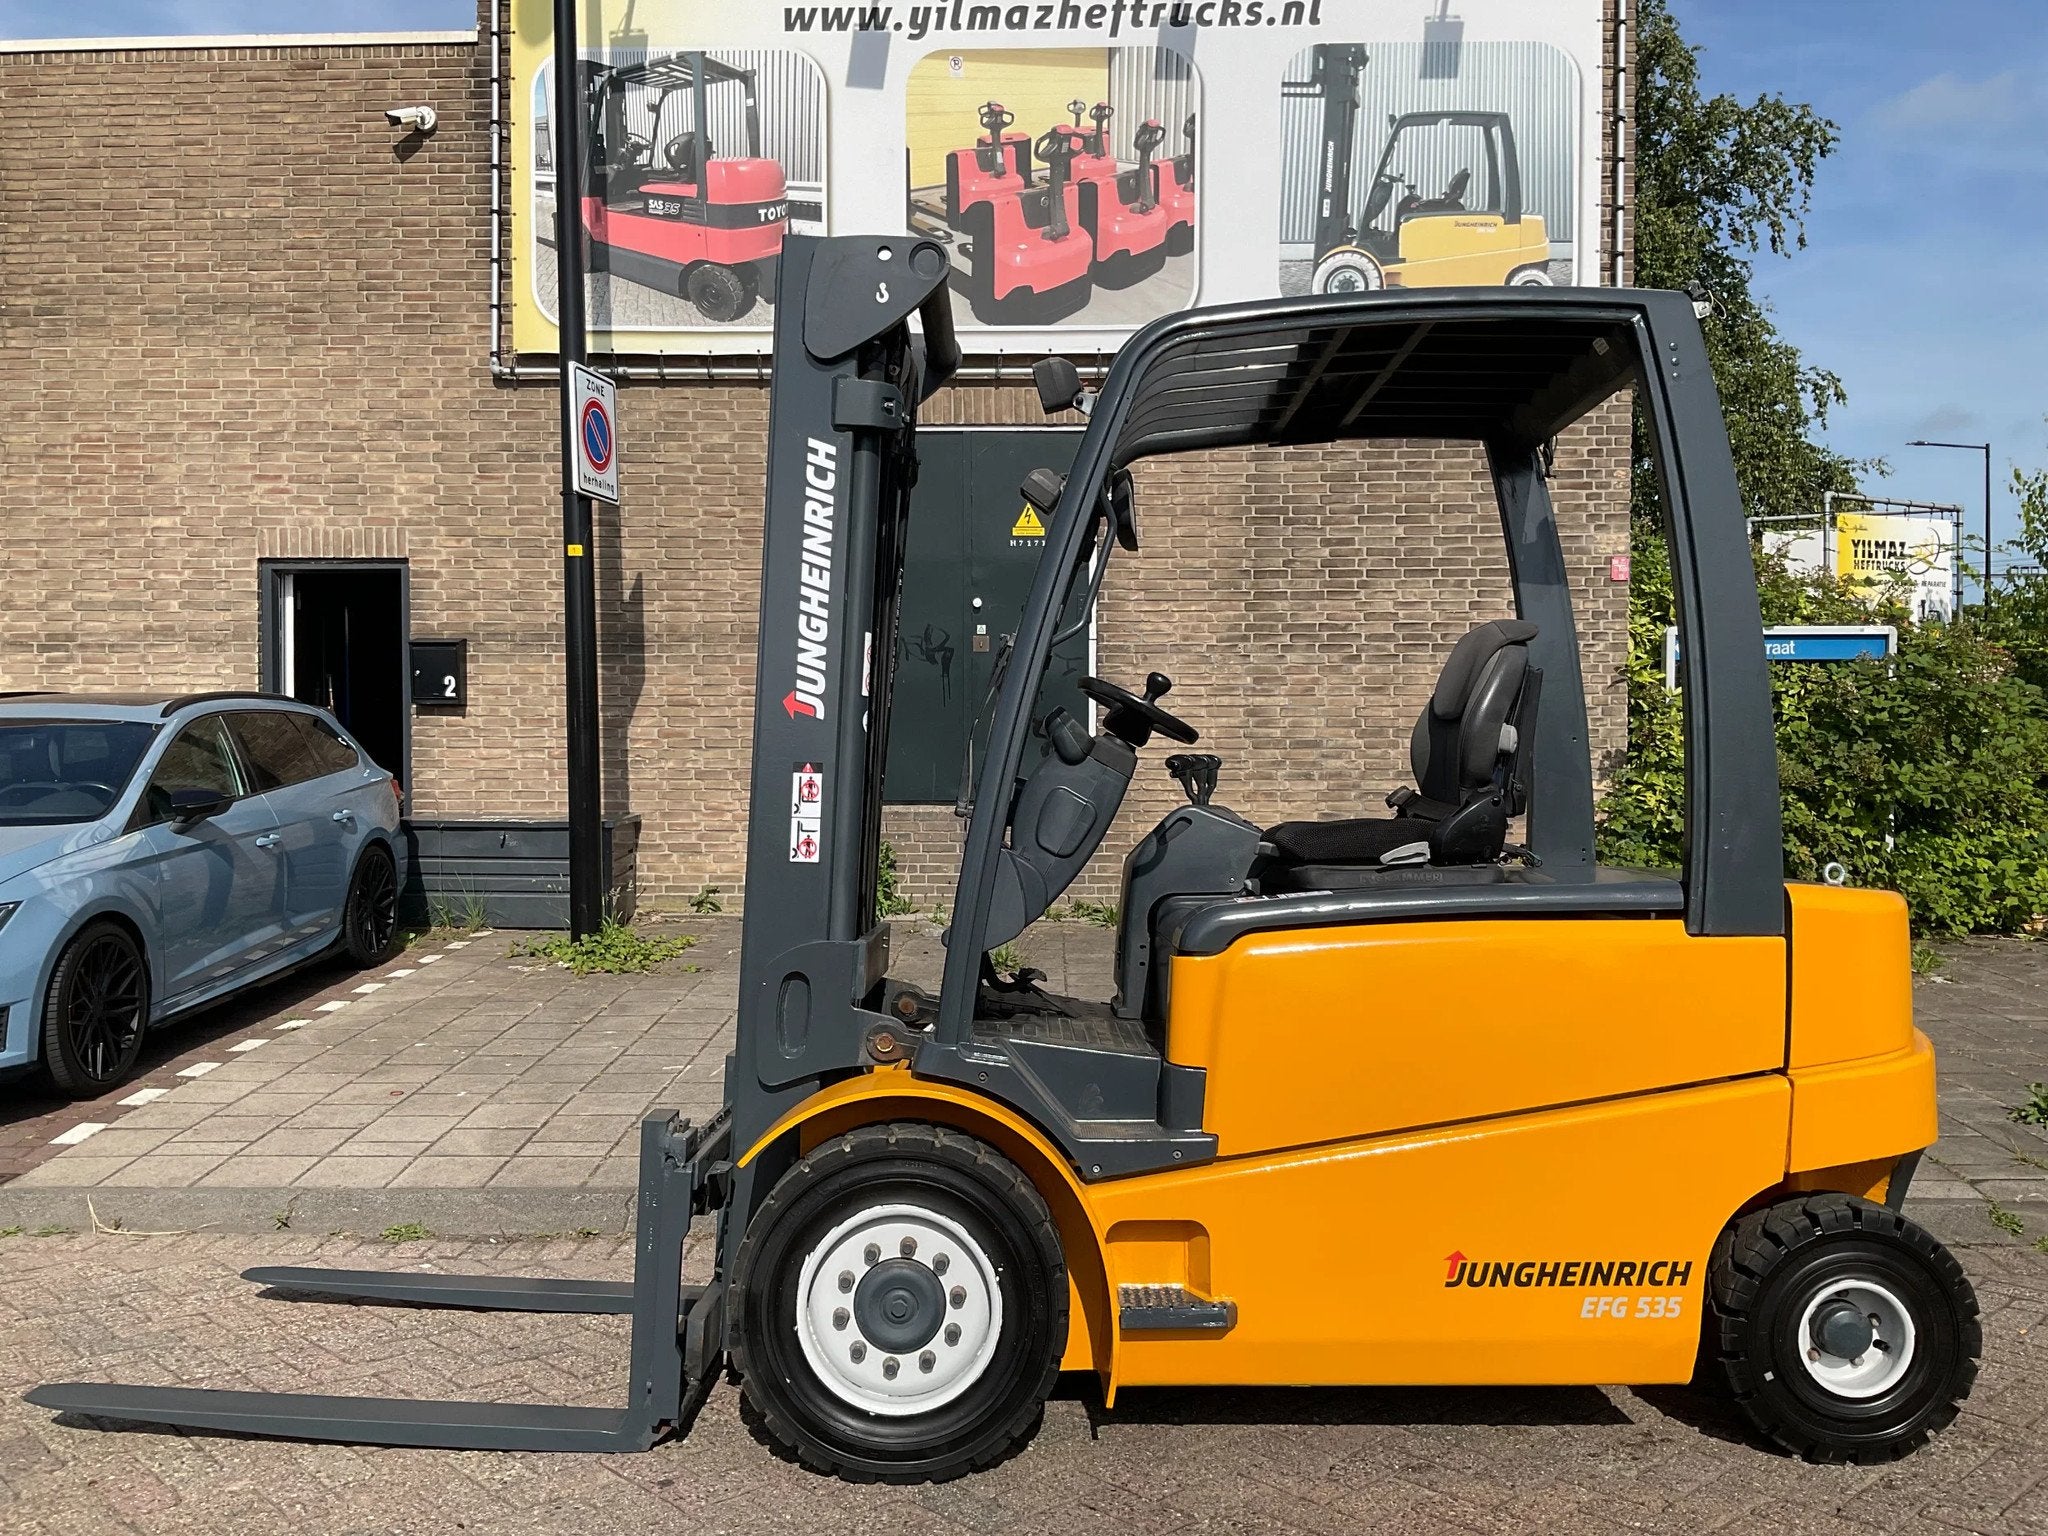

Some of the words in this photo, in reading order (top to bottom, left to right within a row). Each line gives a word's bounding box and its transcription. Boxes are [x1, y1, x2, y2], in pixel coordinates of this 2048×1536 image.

[784, 0, 1321, 40] www.yilmazheftrucks.nl
[648, 199, 664, 210] SAS
[586, 378, 605, 397] ZONE
[583, 472, 615, 496] herhaling
[1851, 539, 1906, 560] YILMAZ
[1853, 560, 1906, 572] HEFTRUCKS
[795, 437, 837, 720] JUNGHEINRICH
[444, 675, 456, 697] 2
[1444, 1260, 1692, 1288] JUNGHEINRICH
[1580, 1296, 1629, 1319] EFG
[1634, 1296, 1683, 1319] 535
